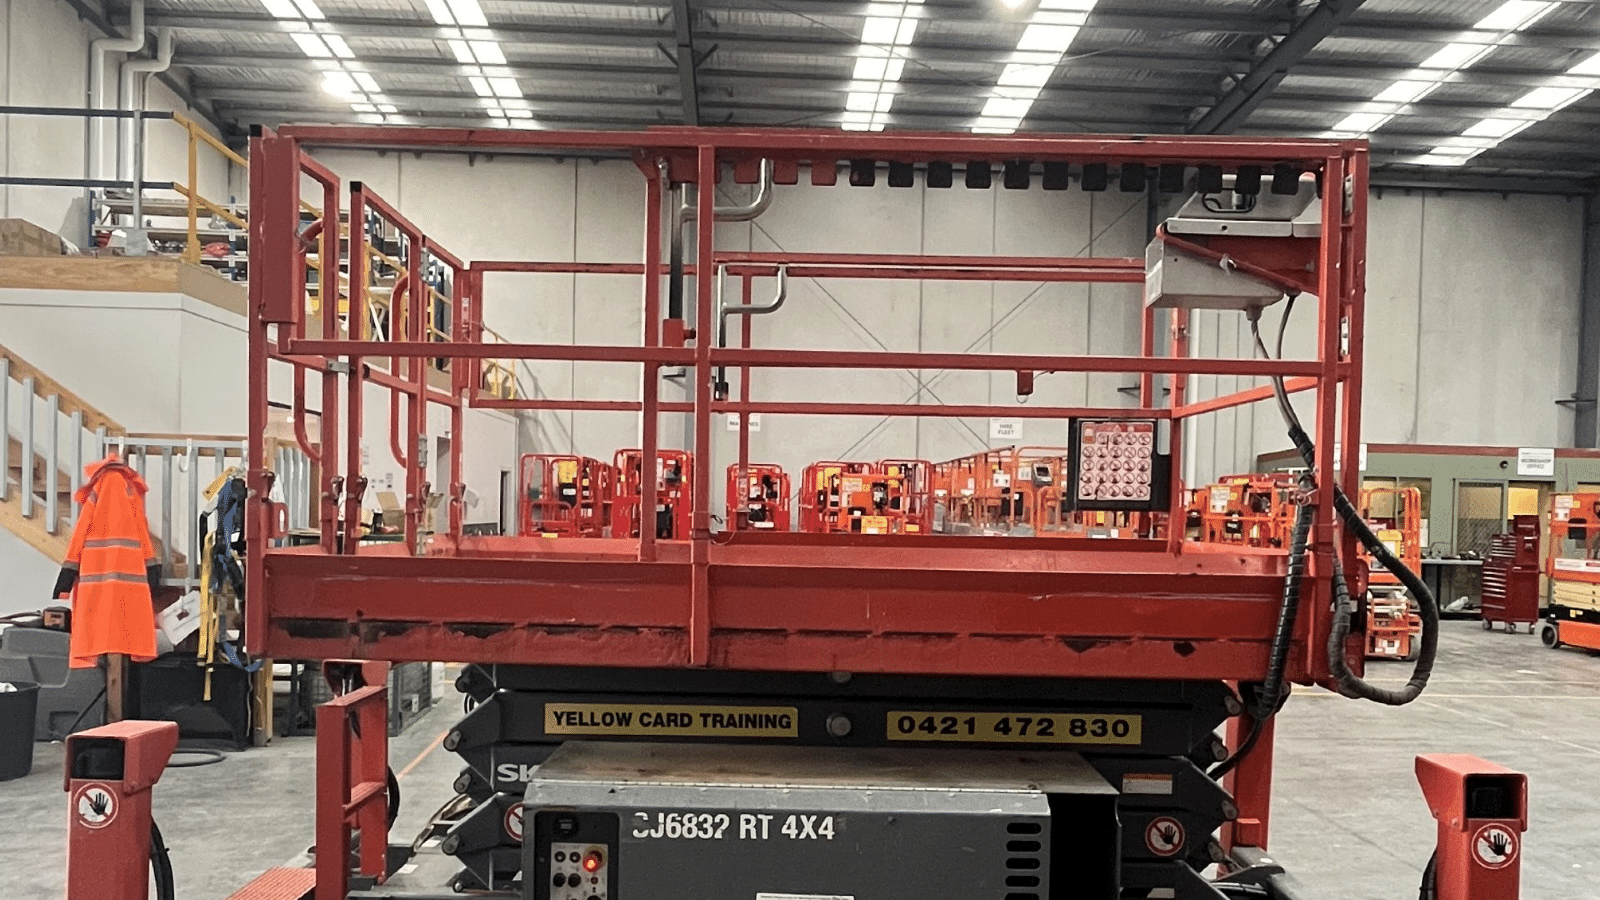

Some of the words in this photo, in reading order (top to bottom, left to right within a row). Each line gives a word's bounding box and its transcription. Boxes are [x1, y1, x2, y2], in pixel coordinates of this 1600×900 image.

[553, 711, 633, 727] YELLOW
[638, 712, 693, 728] CARD
[699, 713, 792, 729] TRAINING
[897, 715, 976, 735] 0421
[993, 717, 1055, 737] 472
[1068, 718, 1130, 738] 830
[739, 814, 774, 839] RT
[781, 815, 835, 840] 4X4
